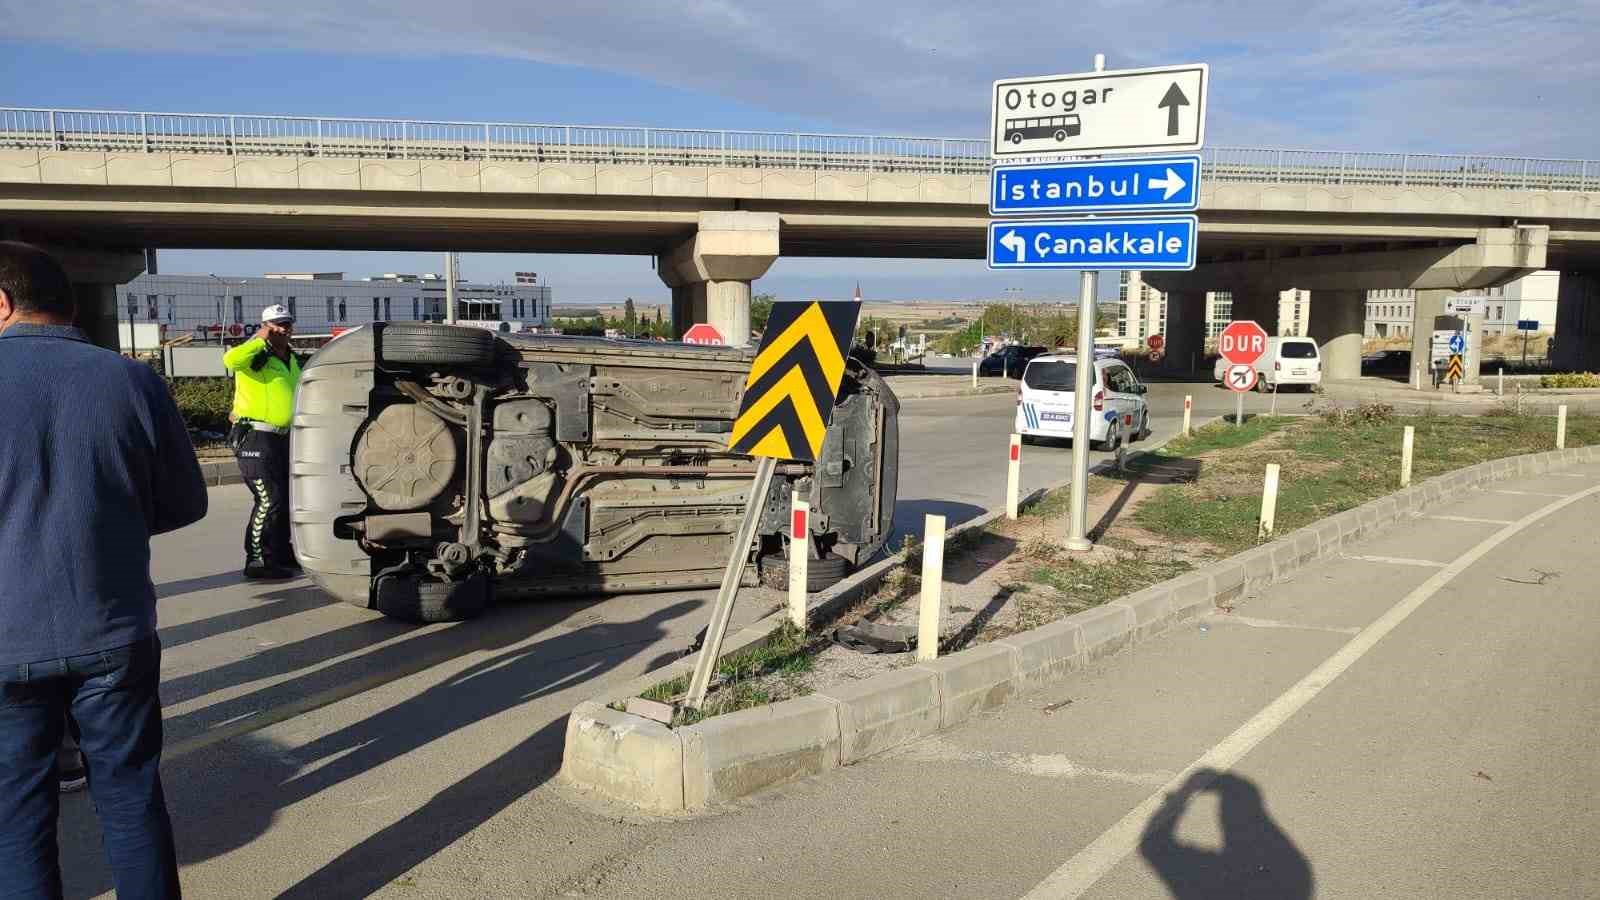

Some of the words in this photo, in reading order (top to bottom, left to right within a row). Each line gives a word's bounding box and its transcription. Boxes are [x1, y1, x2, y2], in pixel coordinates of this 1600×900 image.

[1005, 87, 1113, 112] Otogar
[1000, 172, 1140, 201] İstanbul
[1034, 230, 1183, 258] Çanakkale
[1223, 335, 1263, 352] DUR
